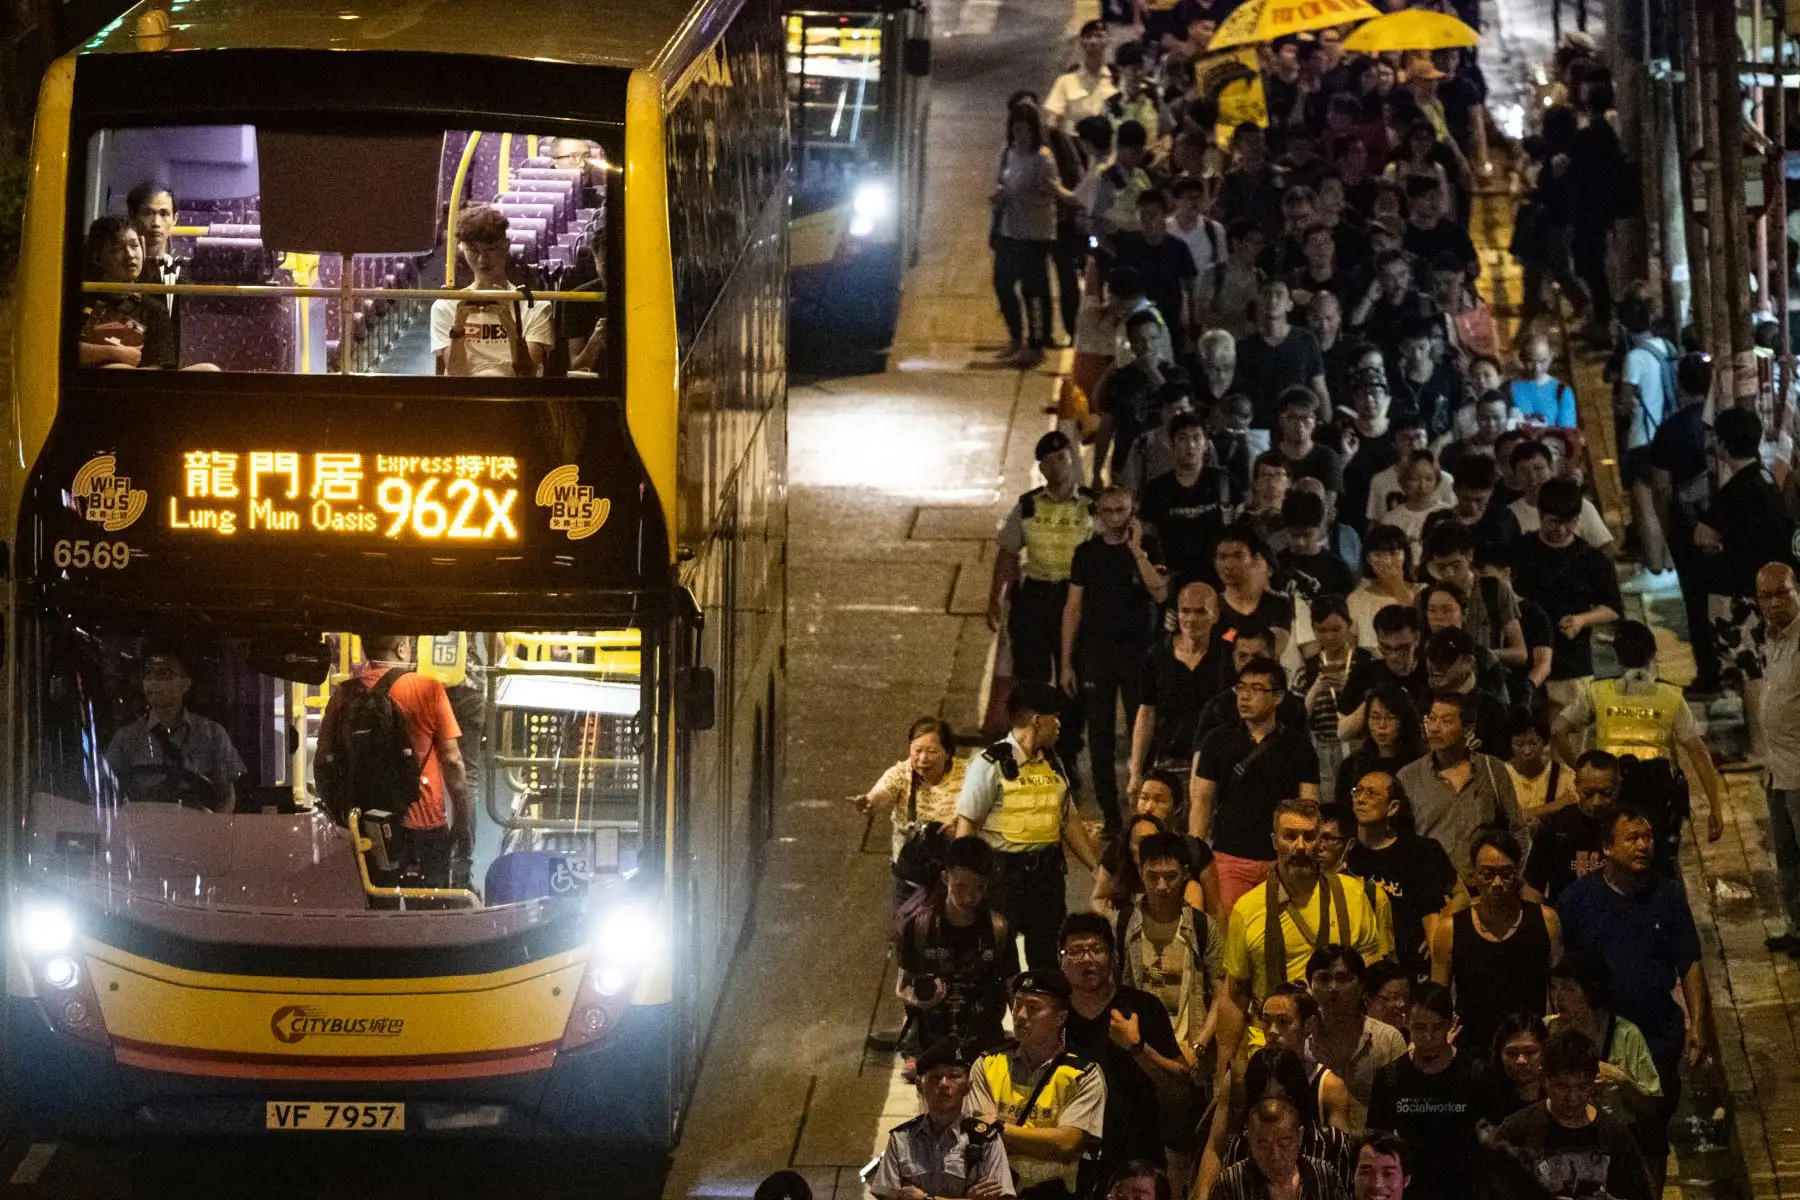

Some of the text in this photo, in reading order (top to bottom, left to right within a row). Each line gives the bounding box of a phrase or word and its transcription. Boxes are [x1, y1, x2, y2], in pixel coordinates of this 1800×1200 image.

[184, 450, 364, 500] 龍門居
[377, 453, 452, 476] Express
[90, 492, 129, 510] BUS
[377, 477, 518, 538] 962X
[553, 502, 593, 519] BUS
[170, 496, 377, 535] Lung Mun Oasis
[54, 540, 130, 570] 6569
[435, 646, 454, 661] 15
[290, 1017, 404, 1034] CITYBUS 城巴
[274, 1105, 397, 1129] VF 7957
